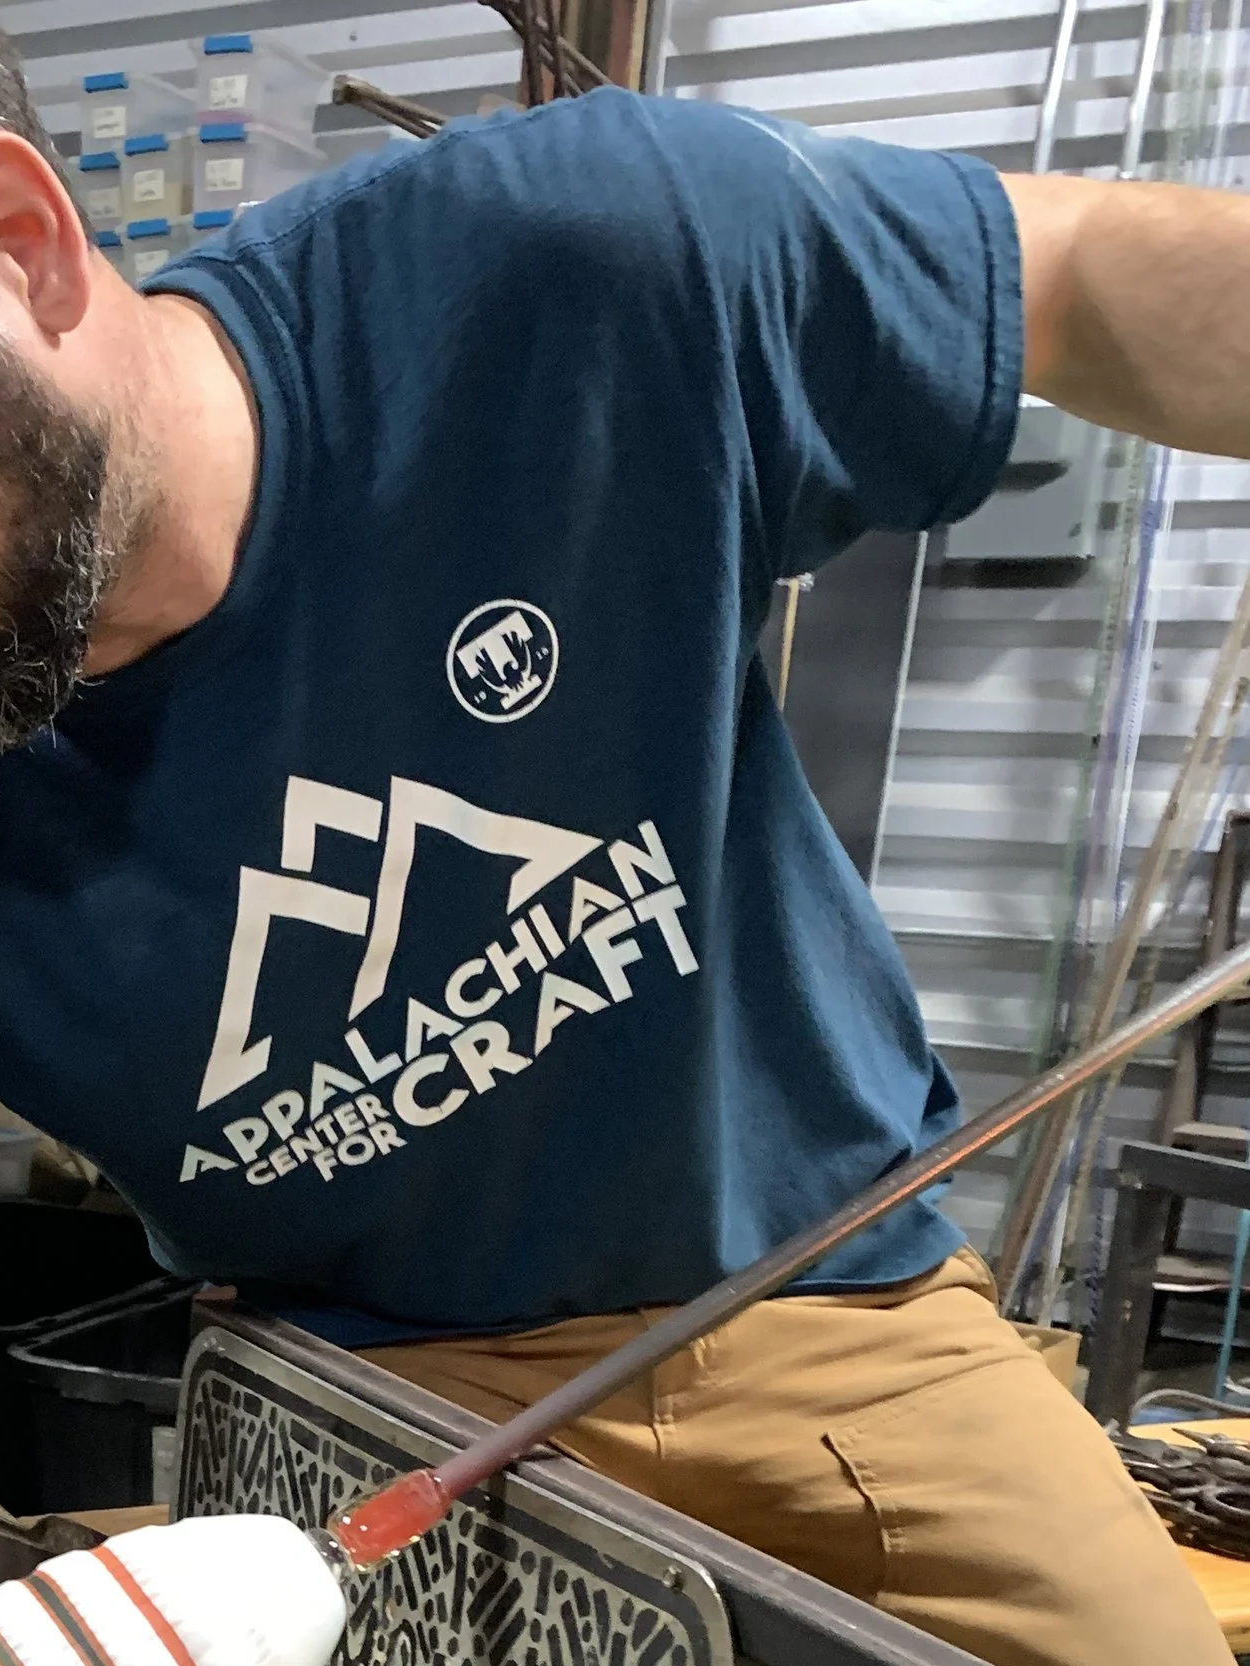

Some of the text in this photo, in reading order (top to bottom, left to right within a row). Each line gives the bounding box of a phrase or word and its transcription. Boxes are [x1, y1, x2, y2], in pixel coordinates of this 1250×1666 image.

[179, 819, 677, 1183] APPALACHIAN
[393, 885, 700, 1127] CRAFT
[245, 1093, 391, 1186] CENTER
[313, 1120, 408, 1183] FOR
